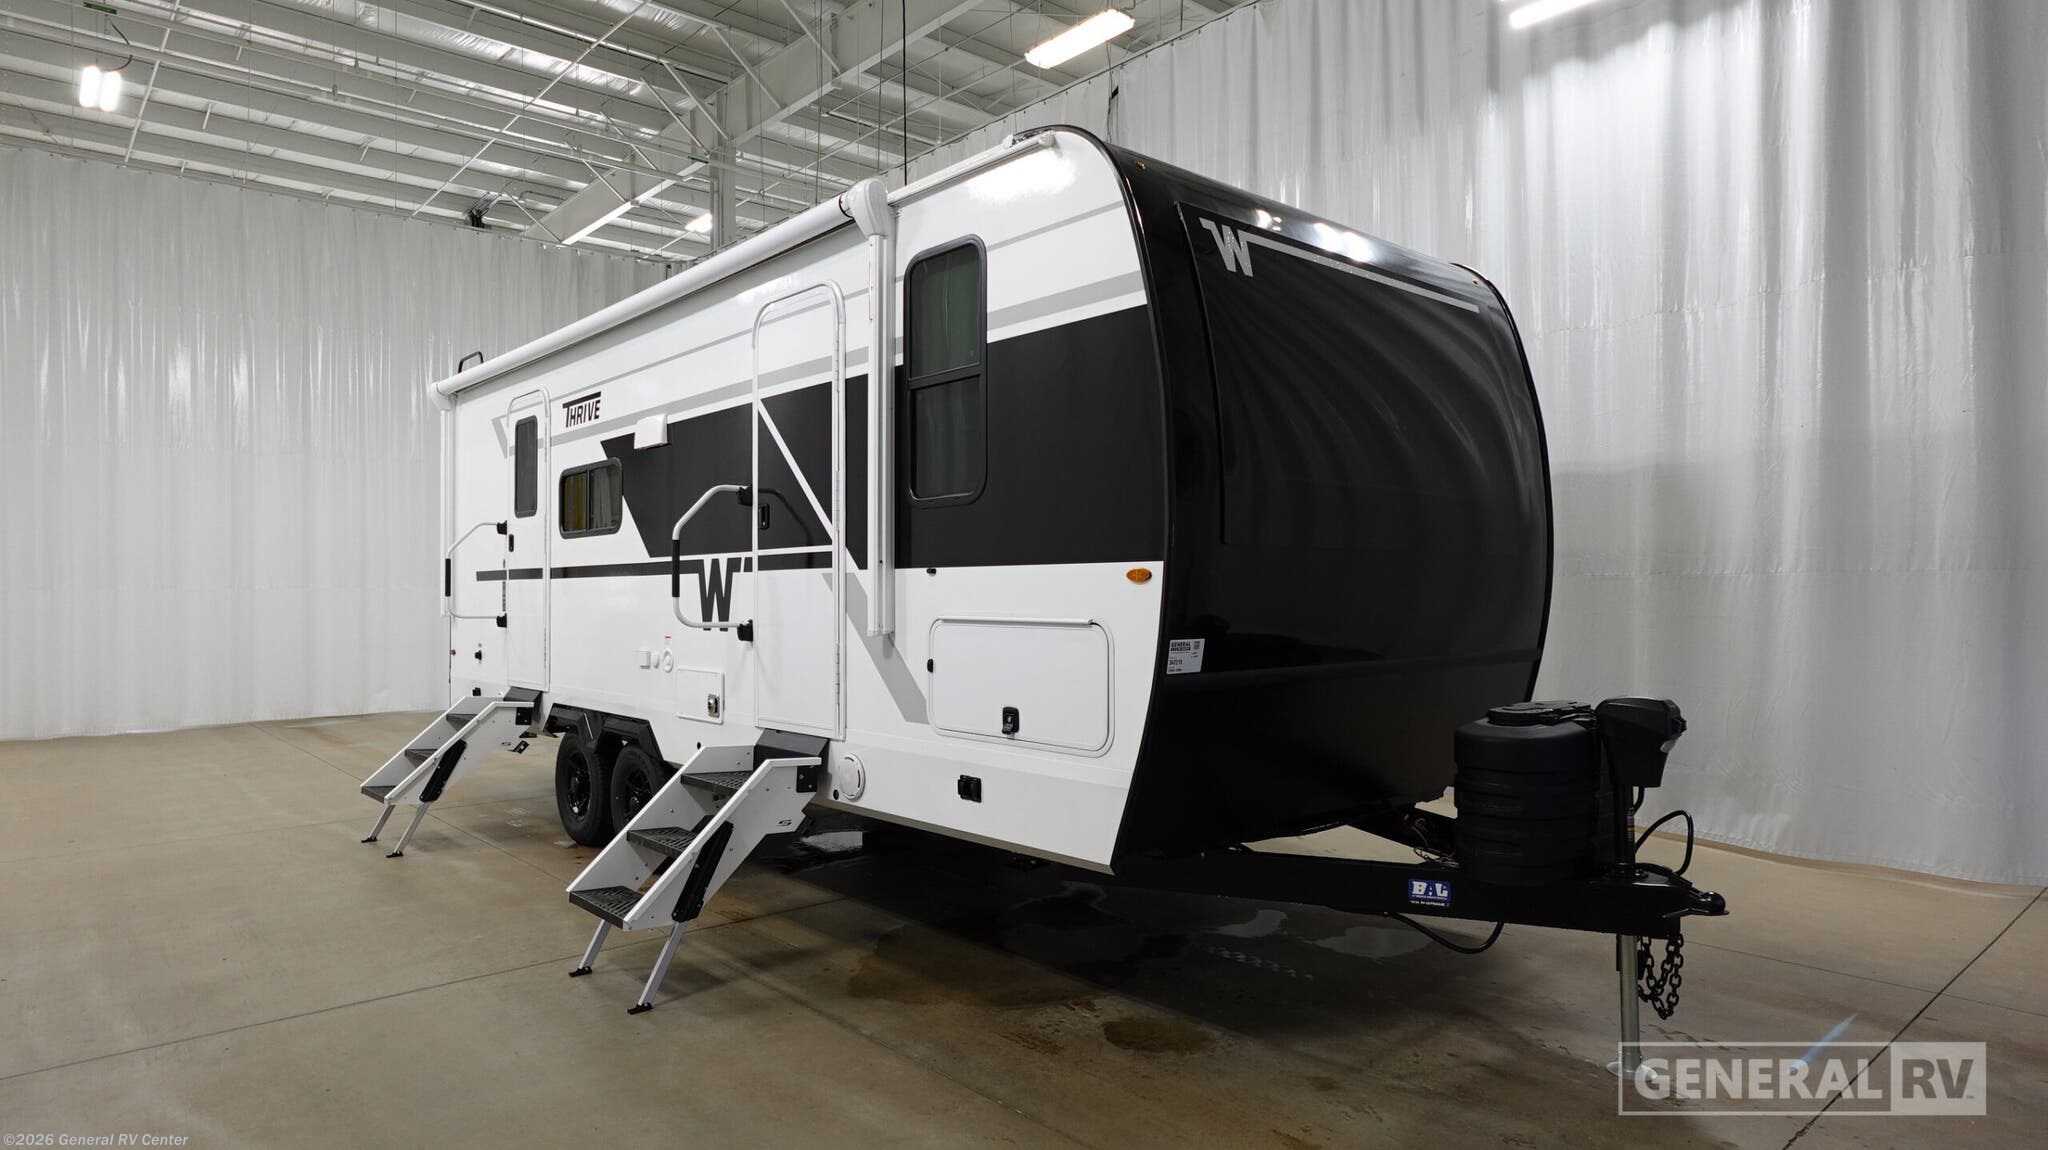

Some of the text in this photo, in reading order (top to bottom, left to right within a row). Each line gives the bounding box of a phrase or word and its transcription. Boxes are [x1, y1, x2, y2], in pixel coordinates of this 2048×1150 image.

[1199, 217, 1254, 277] W
[562, 391, 602, 428] THRIVE
[696, 557, 742, 631] W
